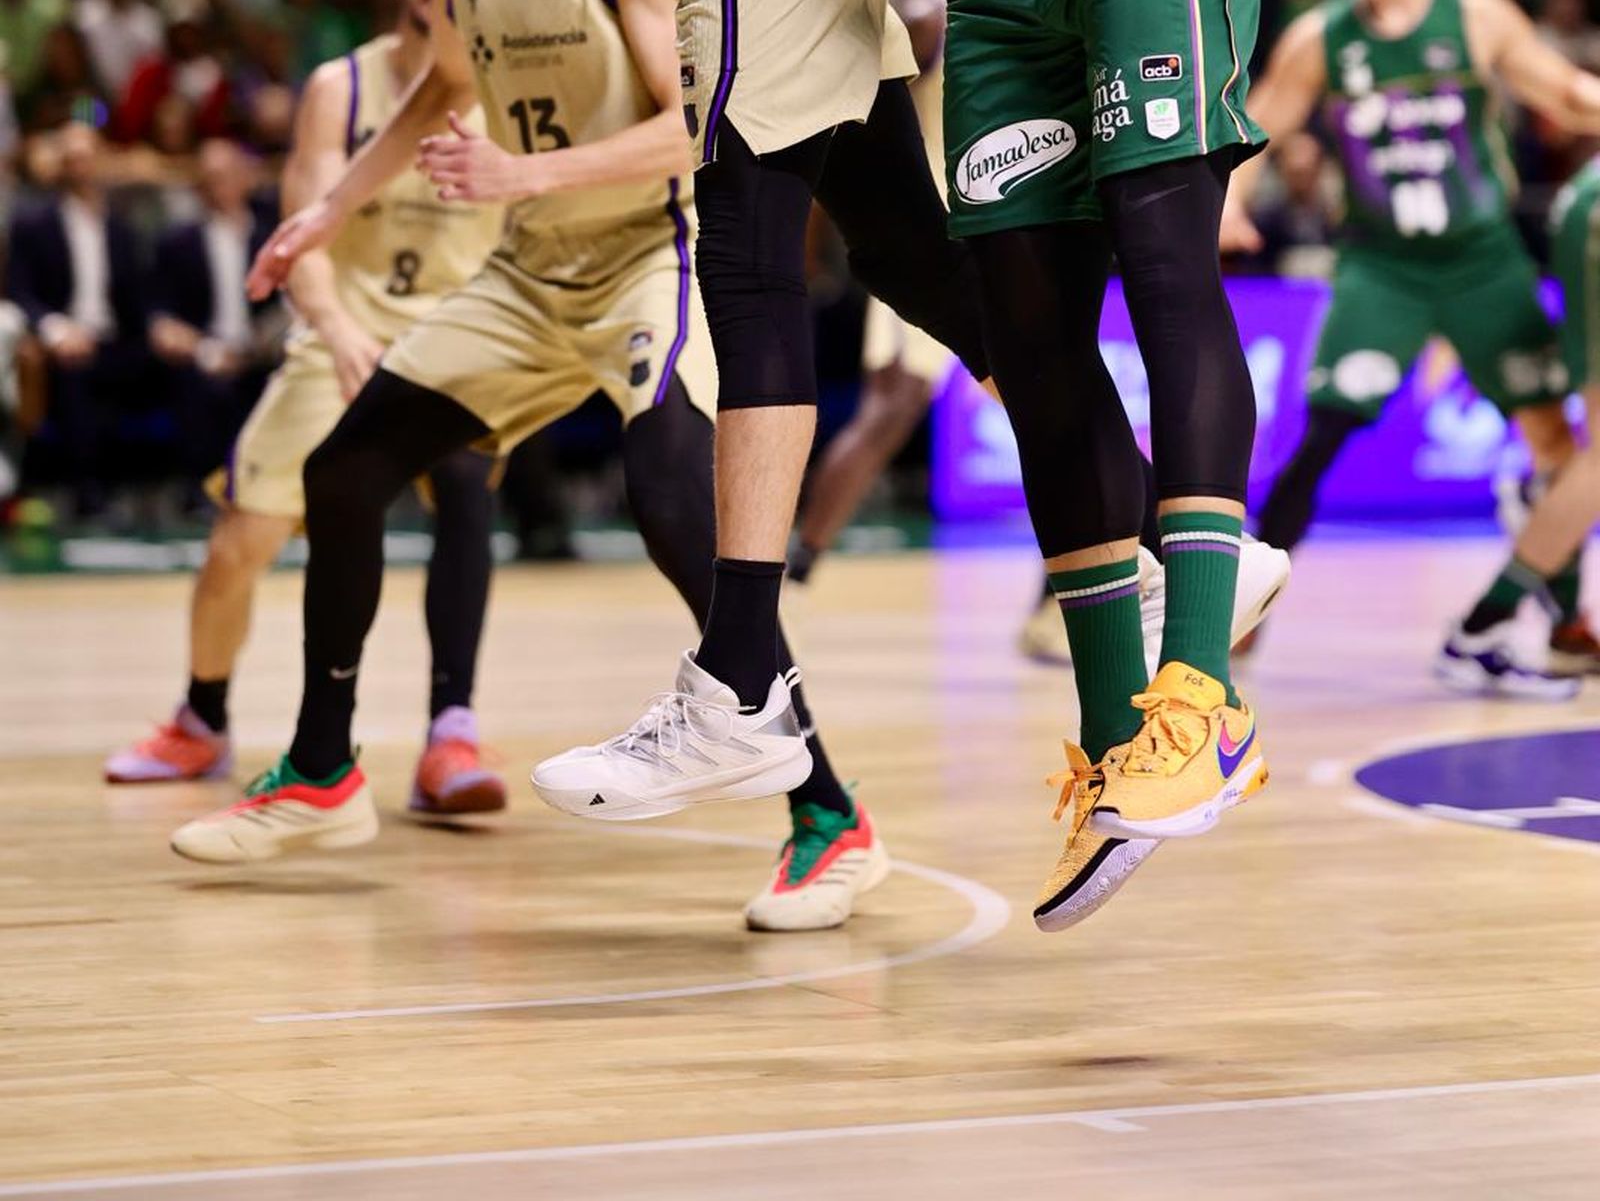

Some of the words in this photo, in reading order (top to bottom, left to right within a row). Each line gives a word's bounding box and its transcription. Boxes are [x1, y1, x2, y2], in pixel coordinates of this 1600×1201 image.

[1144, 64, 1173, 78] acb
[508, 98, 573, 155] 13
[1092, 106, 1134, 142] aga
[964, 126, 1070, 195] famadesa
